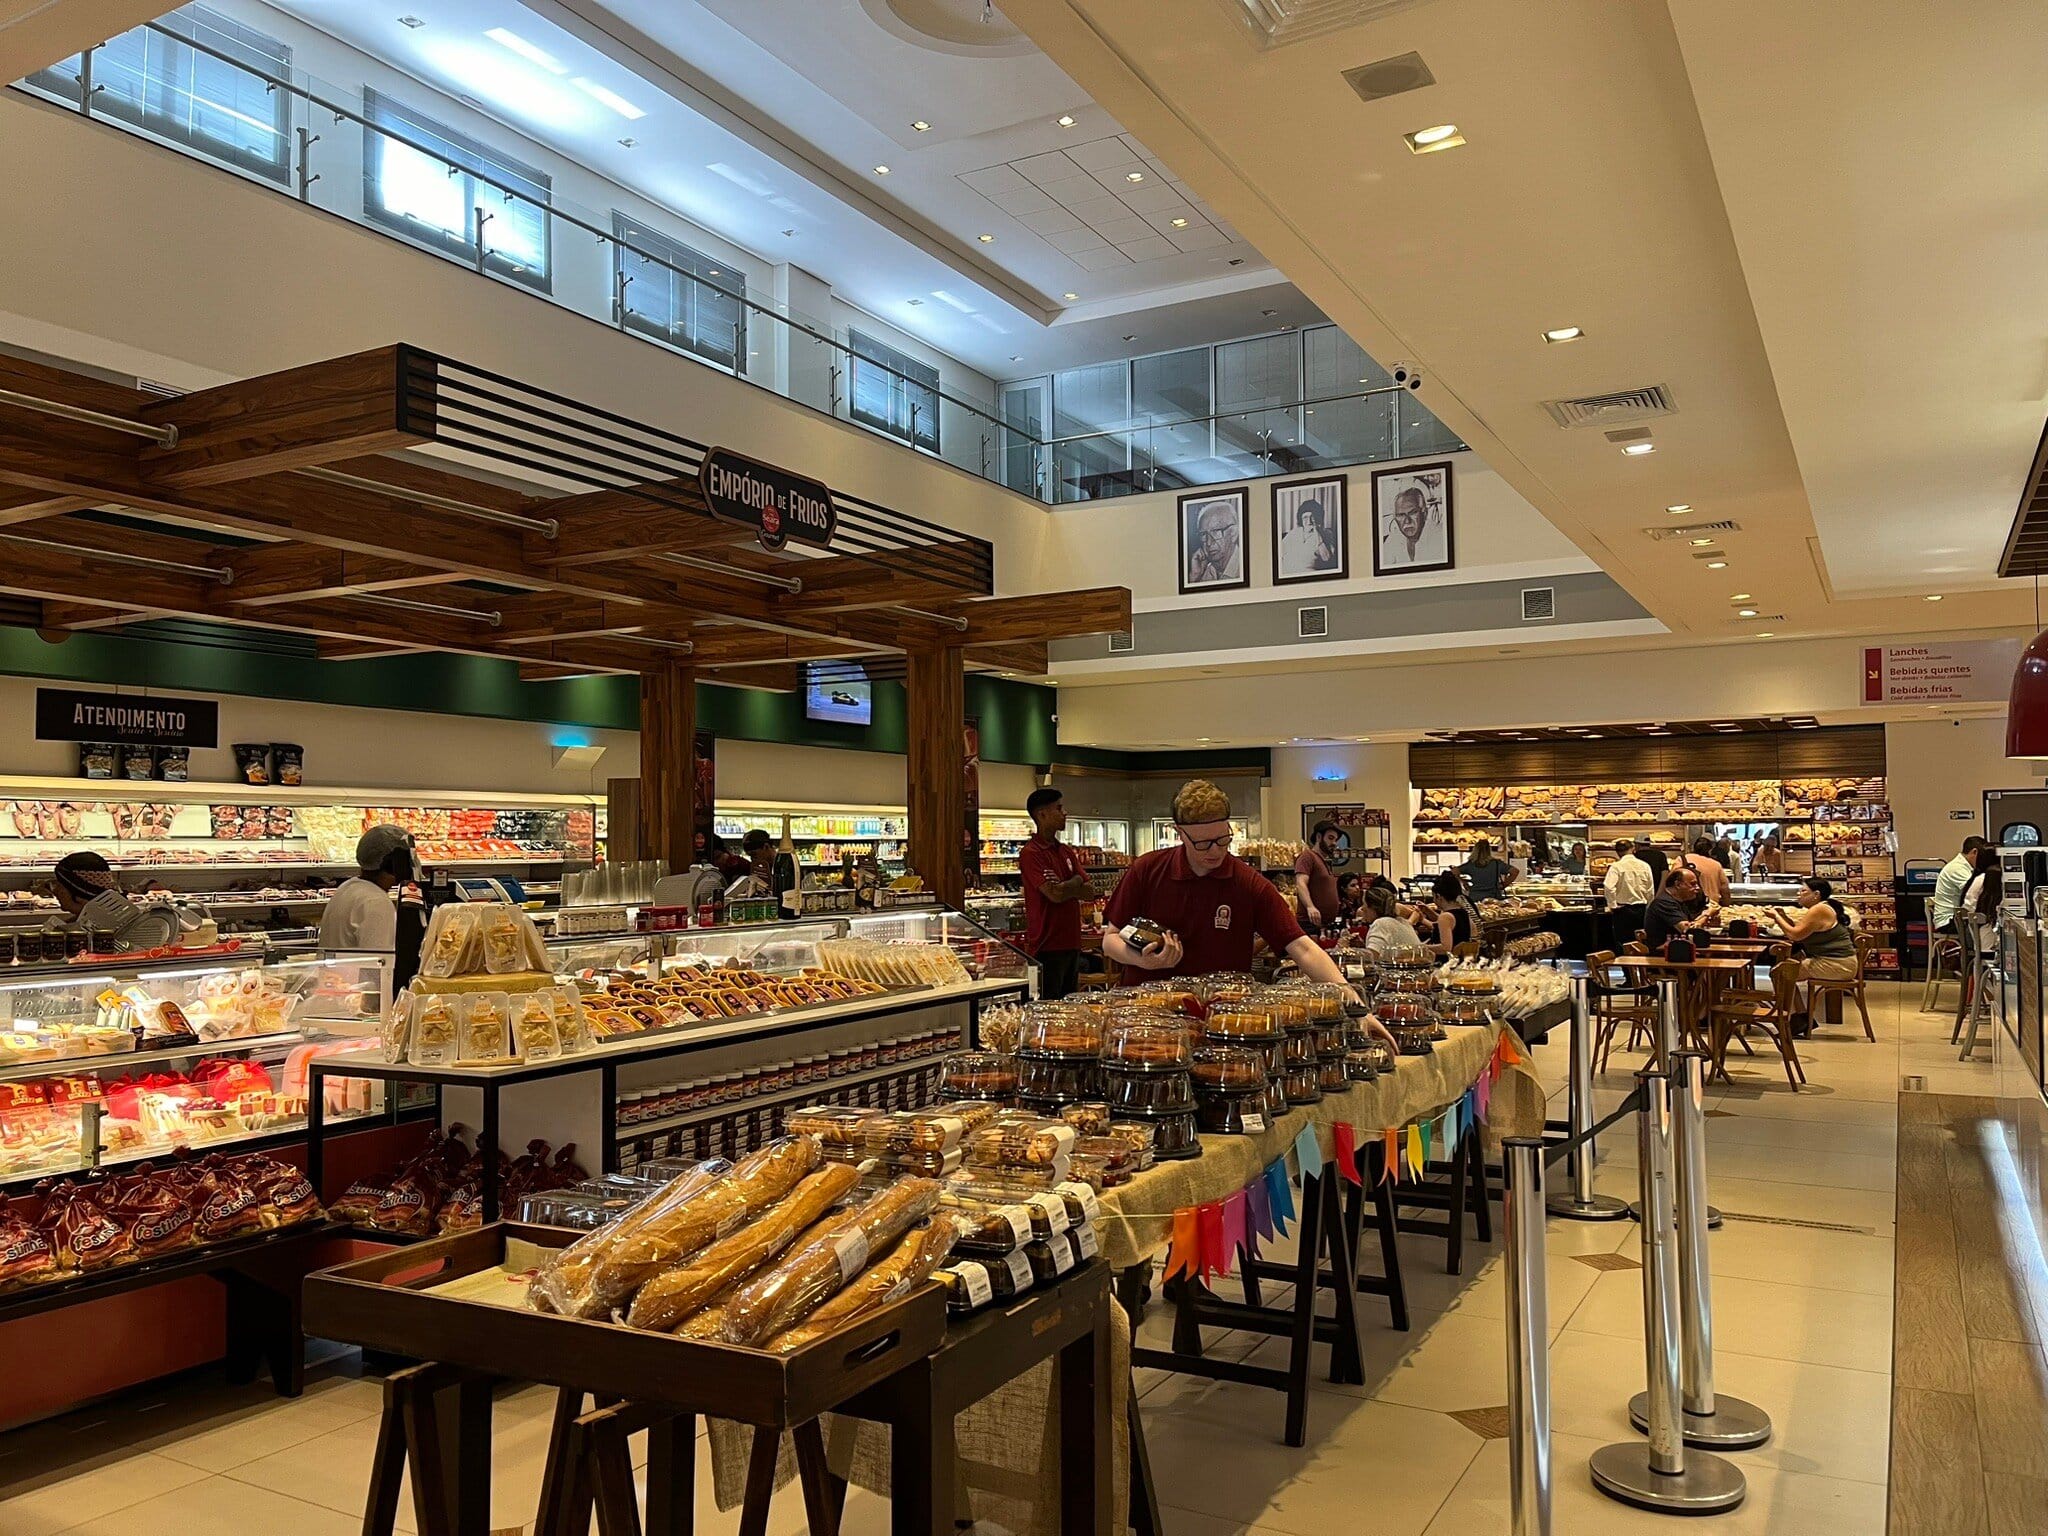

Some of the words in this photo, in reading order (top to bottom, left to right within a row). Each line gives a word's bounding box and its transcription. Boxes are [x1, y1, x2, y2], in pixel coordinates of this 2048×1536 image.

[709, 462, 775, 510] EMPÓRIO
[777, 494, 787, 510] DE
[789, 489, 828, 529] FRIOS
[1889, 647, 1929, 656] Lanches
[1890, 666, 1928, 676] Bebidas
[1930, 666, 1971, 675] quentes
[1890, 685, 1929, 695] Bebidas
[73, 703, 186, 730] ATENDIMENTO
[136, 1208, 192, 1240] festinha
